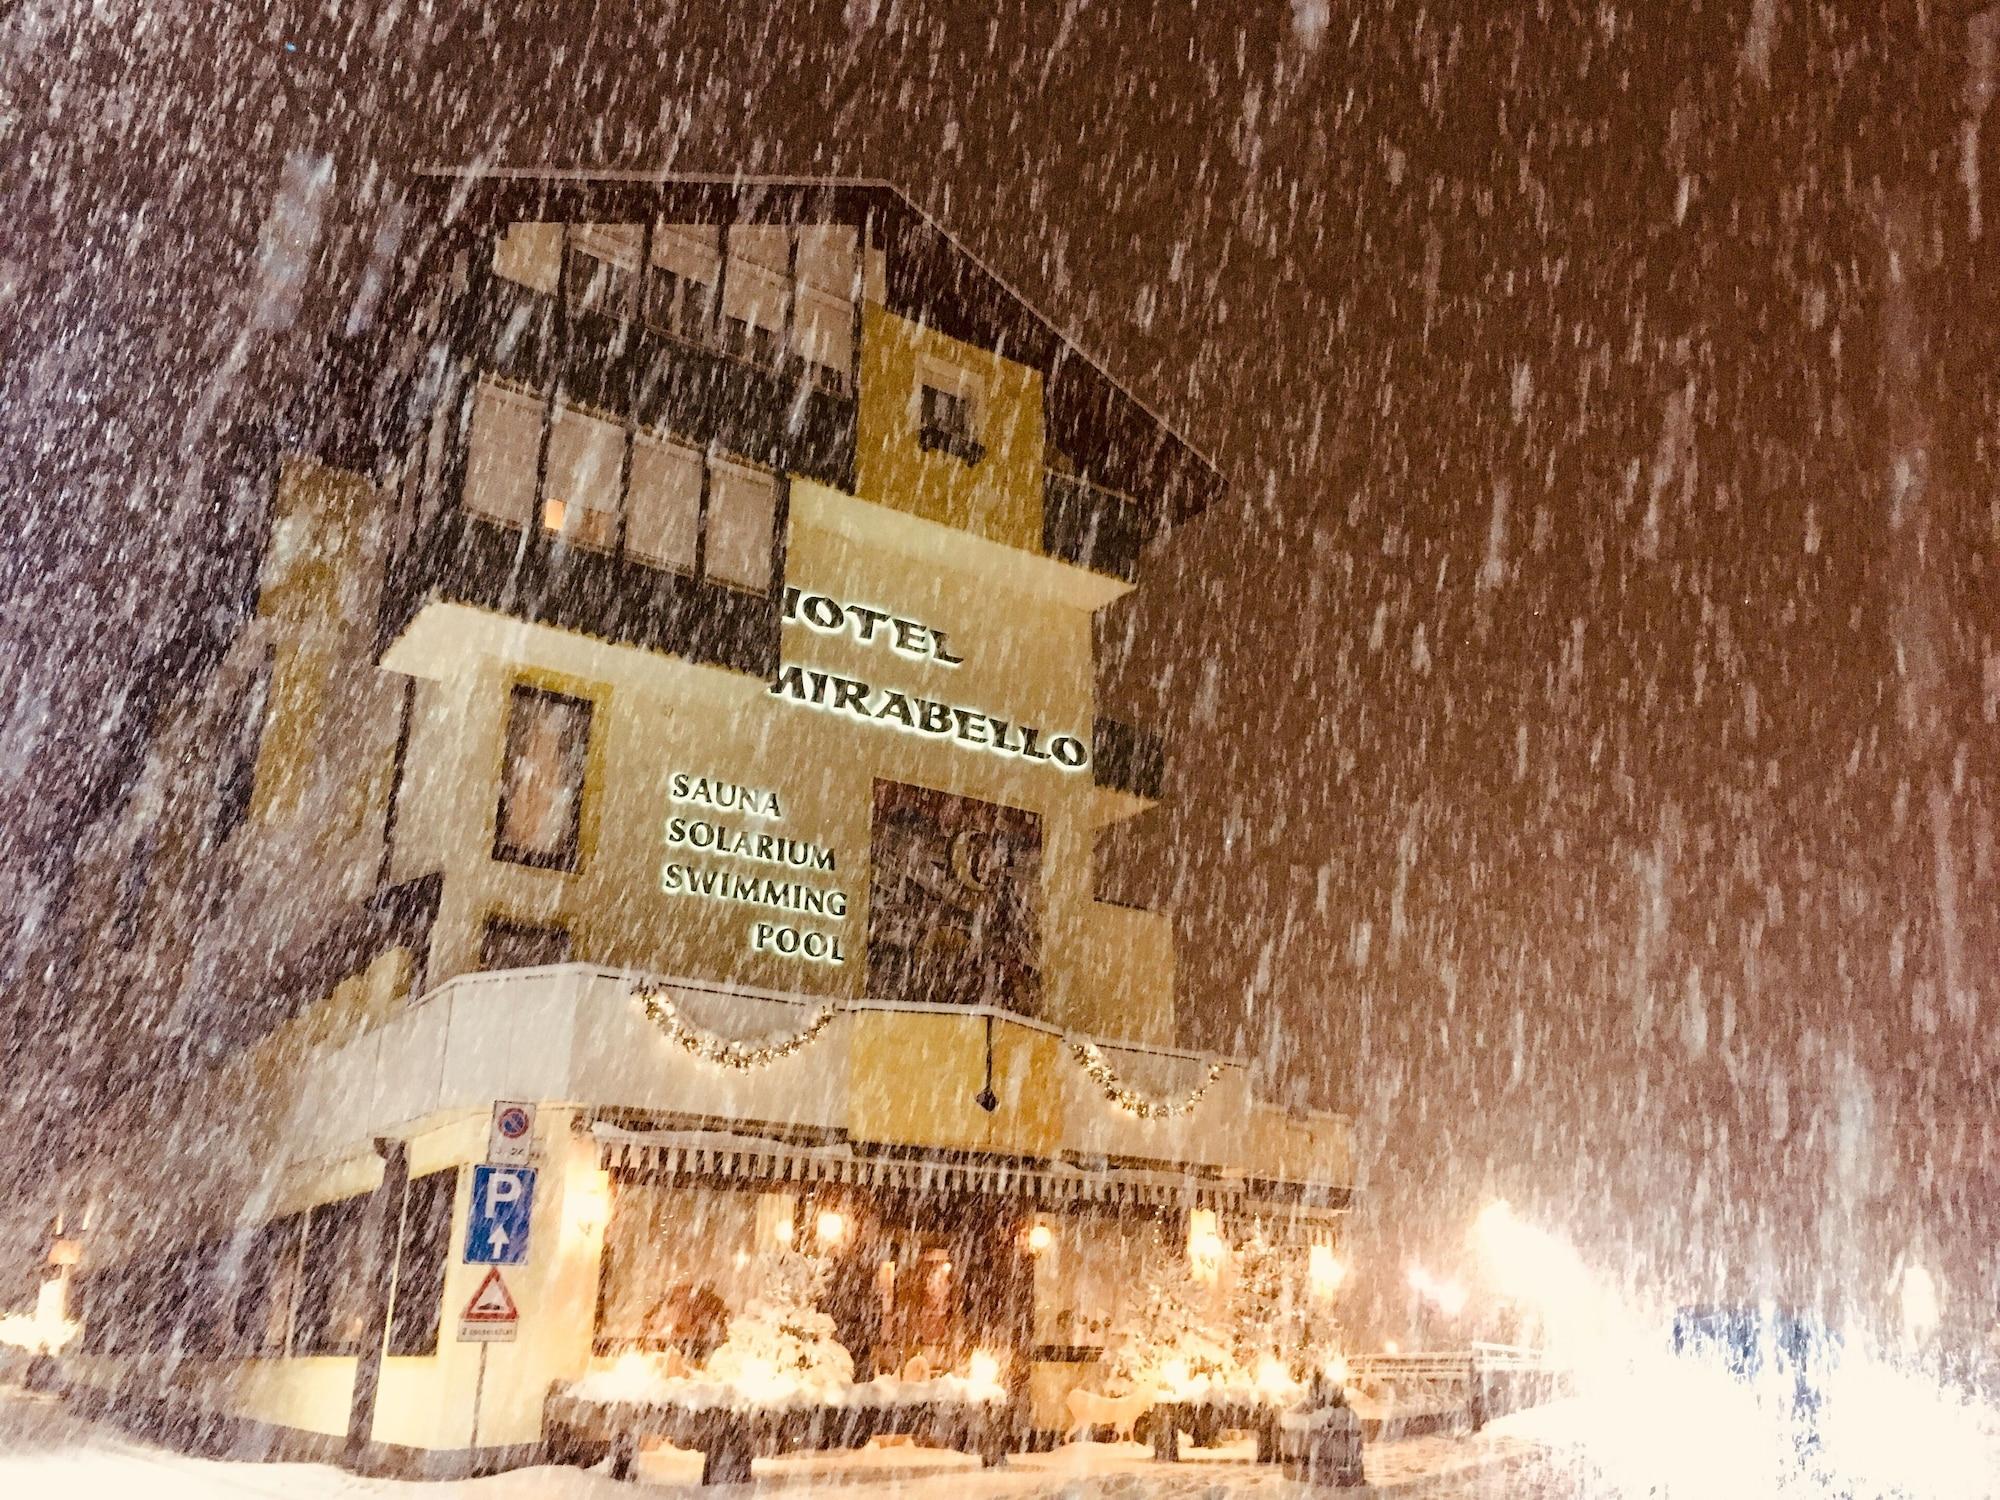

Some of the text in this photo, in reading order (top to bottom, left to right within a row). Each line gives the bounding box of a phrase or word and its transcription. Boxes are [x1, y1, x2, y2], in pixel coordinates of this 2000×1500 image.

[673, 773, 782, 818] SAUNA
[669, 818, 836, 872] SOLARIUM
[665, 864, 848, 916] SWIMMING
[756, 923, 846, 962] POOL
[485, 1172, 522, 1218] P
